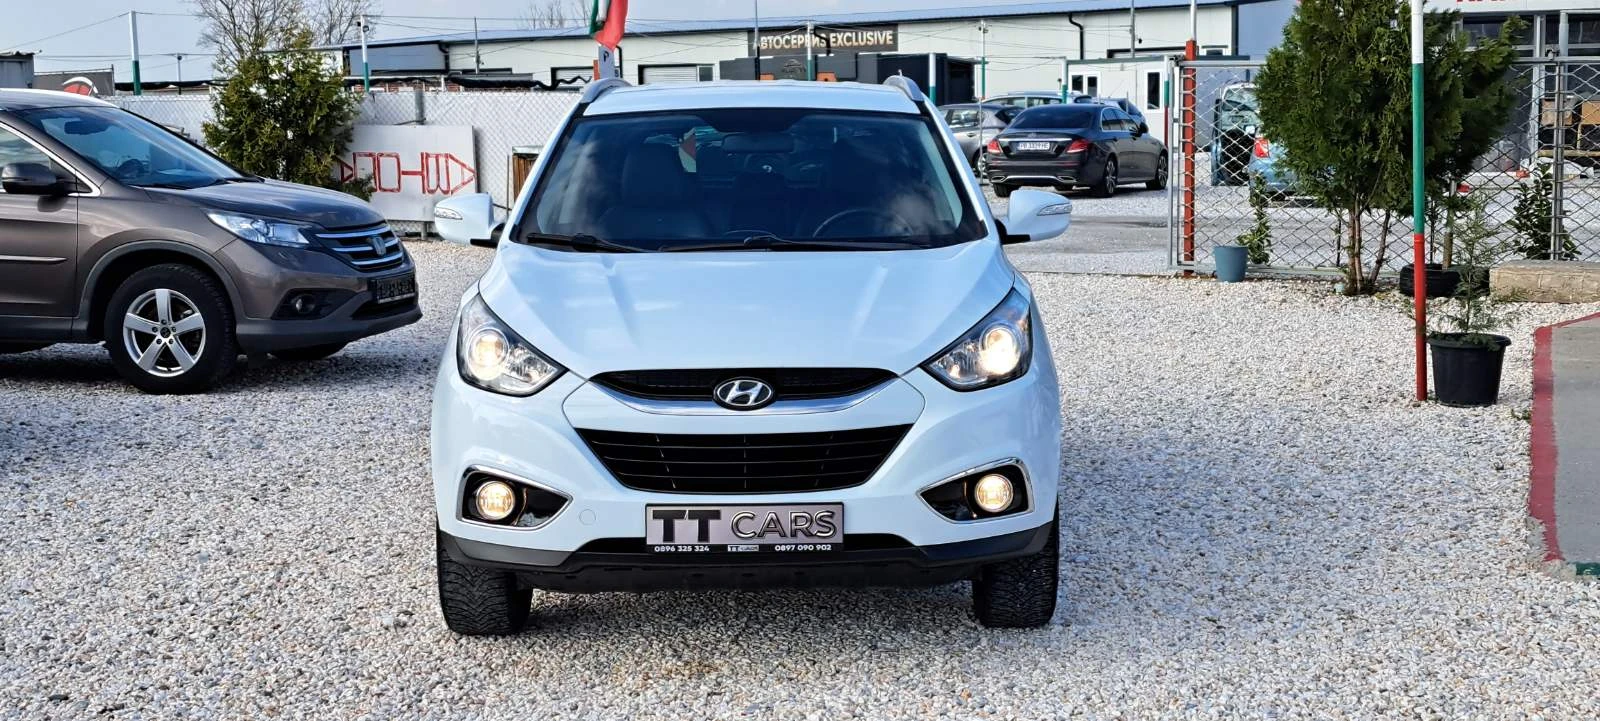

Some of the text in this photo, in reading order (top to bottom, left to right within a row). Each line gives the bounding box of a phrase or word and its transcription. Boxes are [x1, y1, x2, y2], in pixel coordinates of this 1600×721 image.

[753, 30, 894, 49] ВТОСЕРВИЗ EXCLUSIVE
[652, 509, 837, 543] TT CARS
